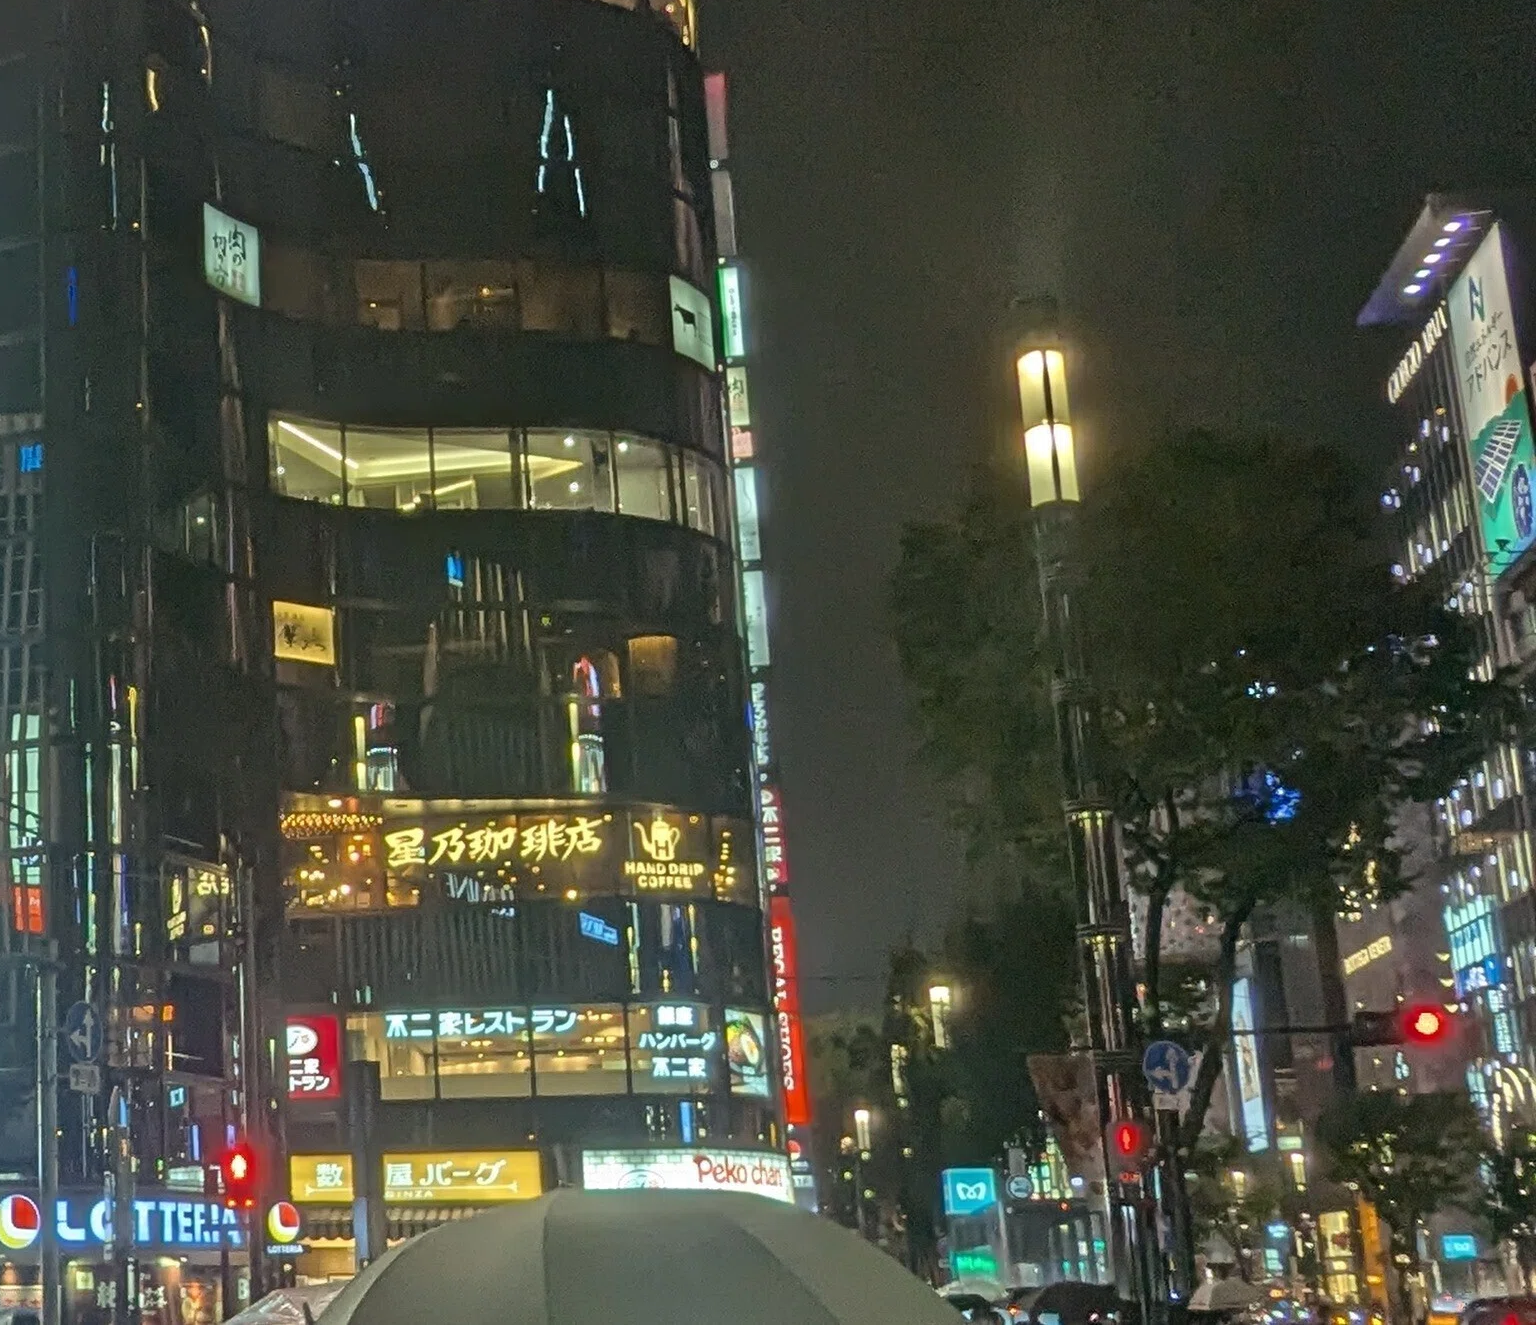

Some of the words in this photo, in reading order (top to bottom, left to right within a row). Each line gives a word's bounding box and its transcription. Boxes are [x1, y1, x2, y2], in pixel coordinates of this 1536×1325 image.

[384, 815, 604, 868] 星乃珈琲店
[624, 861, 667, 876] HAND
[668, 862, 704, 877] DRIP
[637, 876, 693, 890] COFFEE
[384, 1009, 578, 1038] 不二家レストラン
[638, 1031, 716, 1050] ハンバーグ
[651, 1056, 707, 1078] 不二家
[693, 1153, 749, 1184] Peko
[751, 1155, 784, 1188] chan
